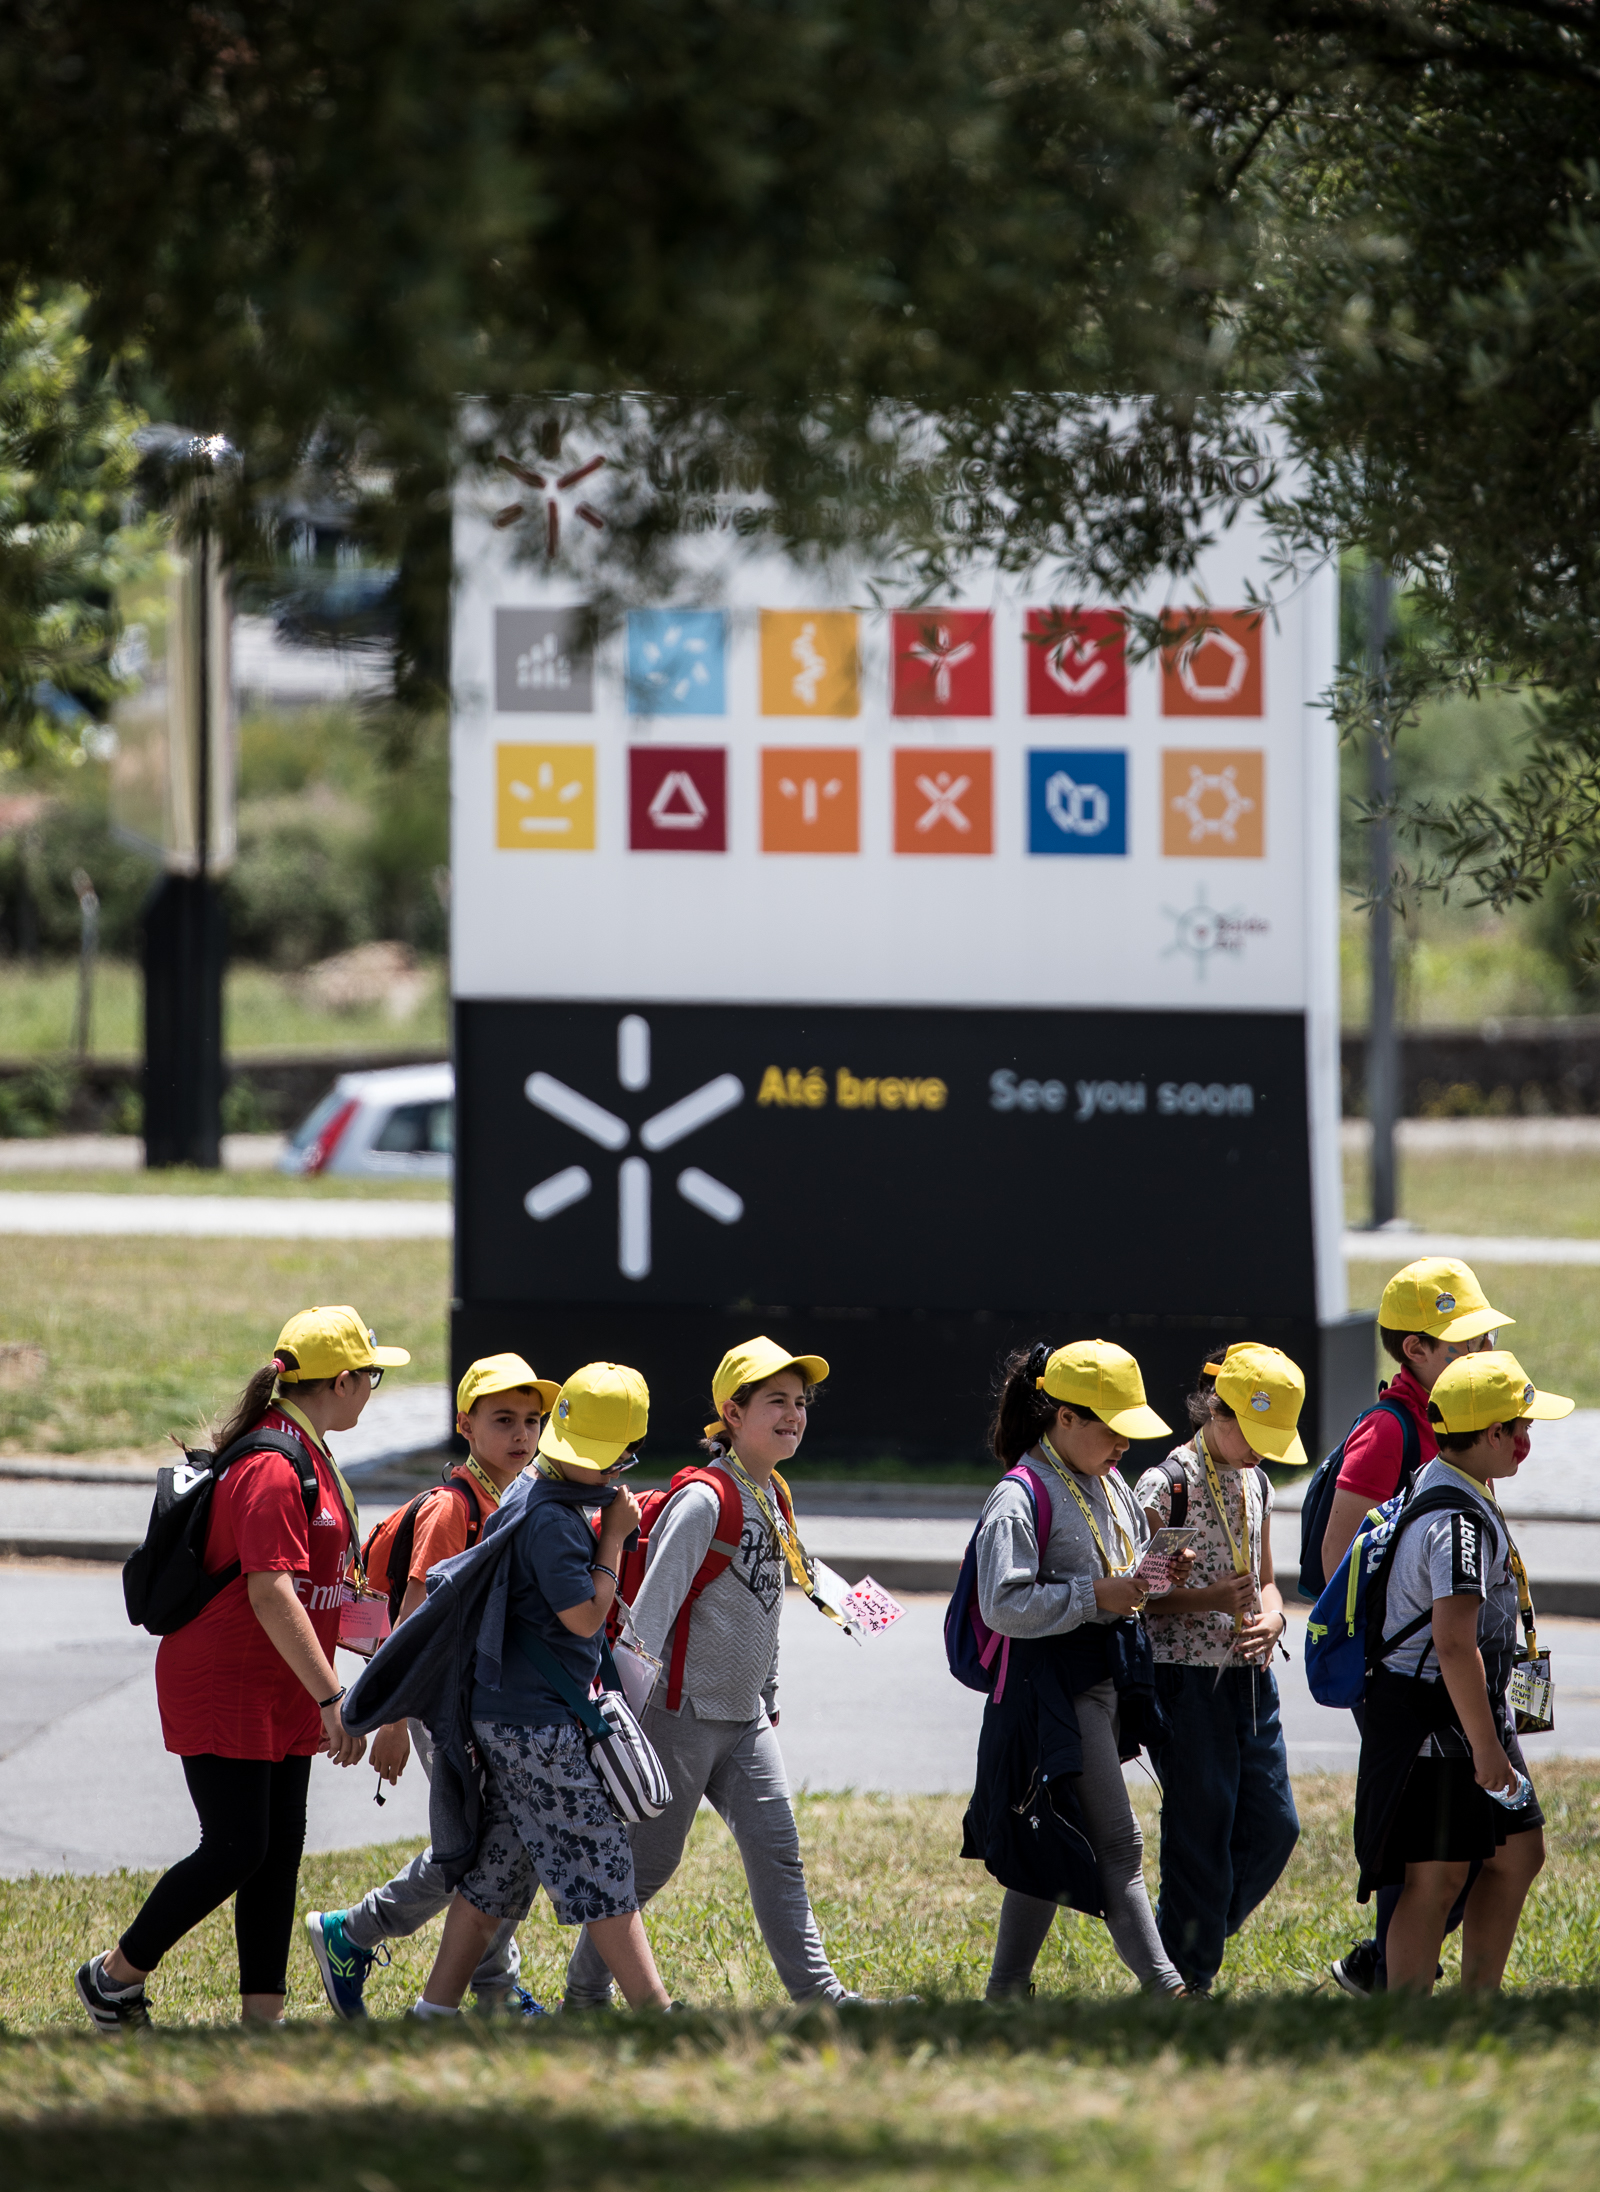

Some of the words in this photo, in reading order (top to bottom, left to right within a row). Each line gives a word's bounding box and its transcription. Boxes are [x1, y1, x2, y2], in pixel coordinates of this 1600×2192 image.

[652, 444, 993, 493] Univrsidde
[758, 1065, 828, 1109] Até
[836, 1067, 948, 1111] breve
[989, 1068, 1067, 1112] See
[1074, 1080, 1147, 1122] you
[1157, 1082, 1254, 1117] soon
[312, 1519, 336, 1527] adidas
[1459, 1514, 1477, 1578] SPORT
